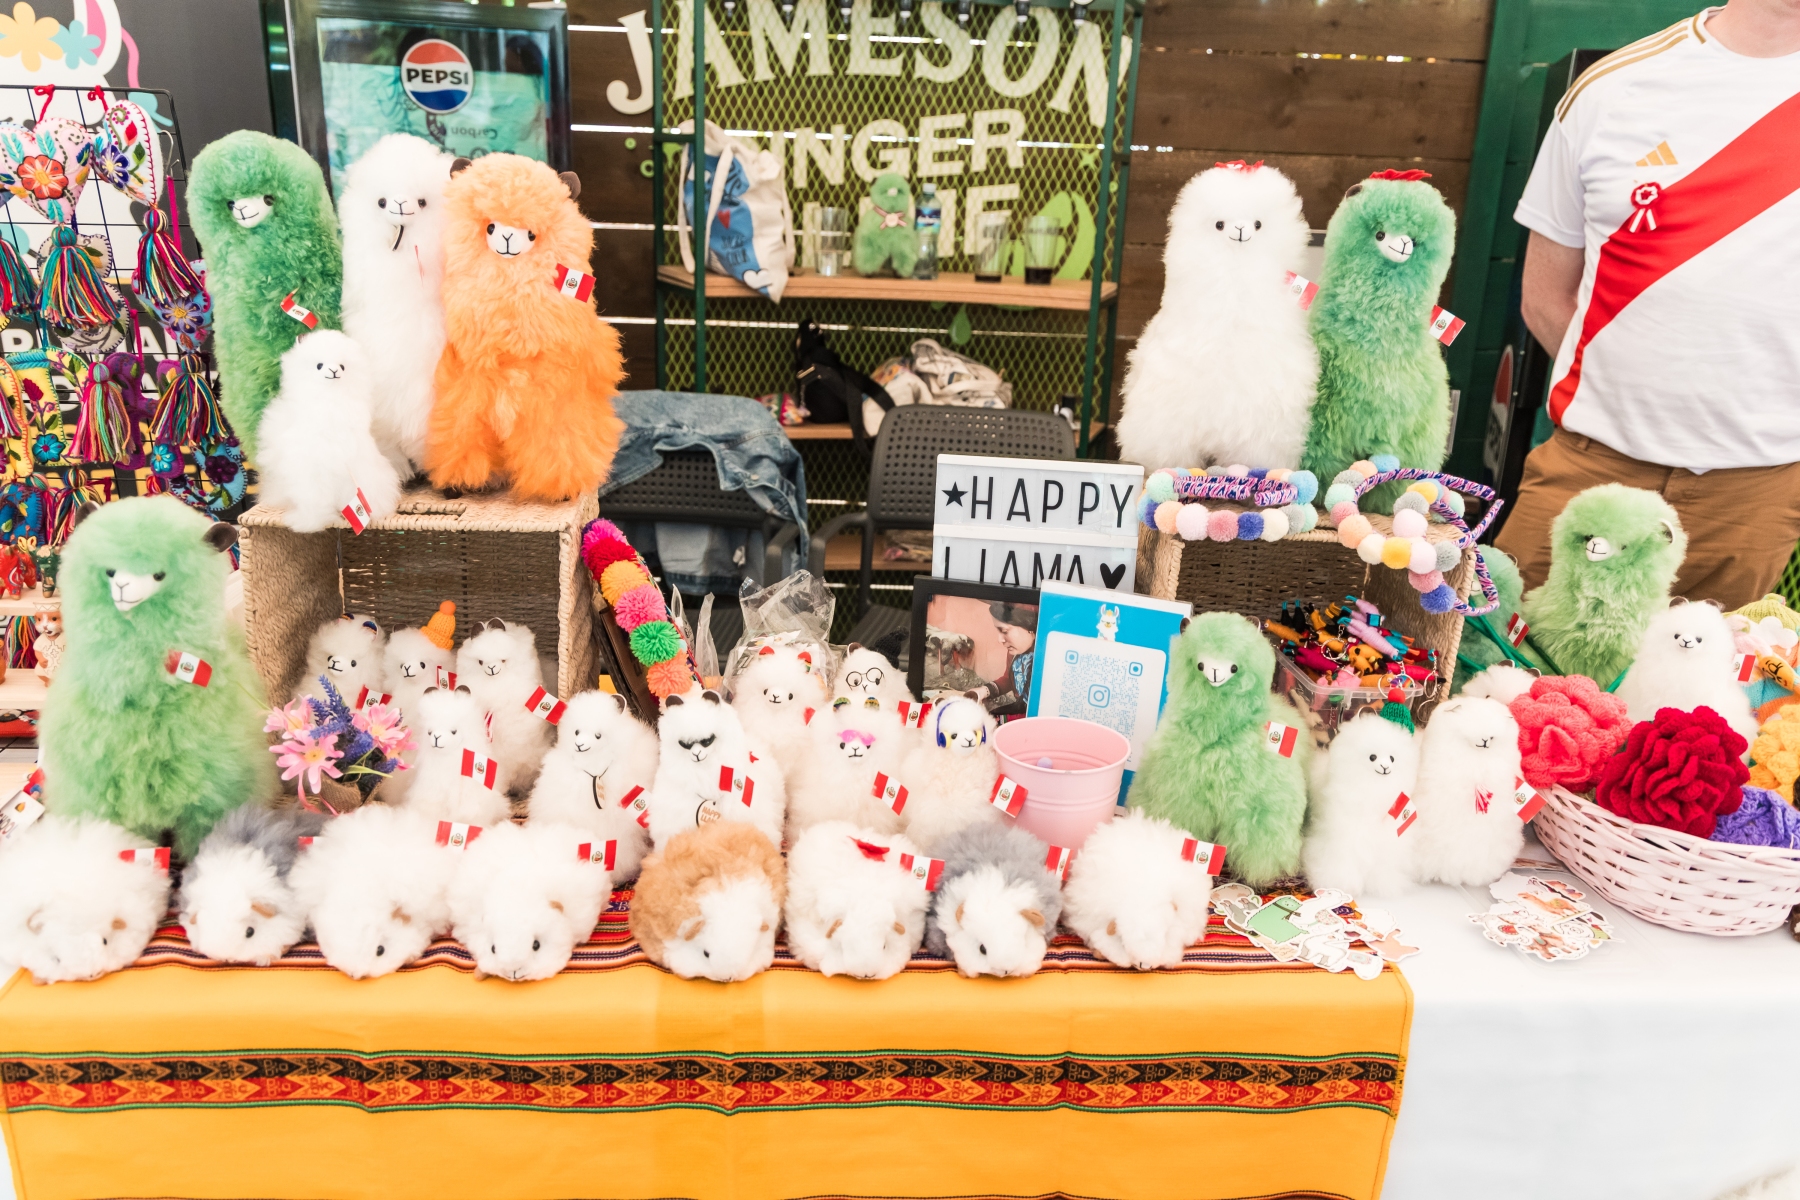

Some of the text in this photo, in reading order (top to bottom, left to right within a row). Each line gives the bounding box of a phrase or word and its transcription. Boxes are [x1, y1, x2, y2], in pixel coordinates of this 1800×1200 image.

[406, 67, 469, 86] PEPSI
[451, 126, 498, 140] Carbon
[970, 475, 1134, 529] HAPPY
